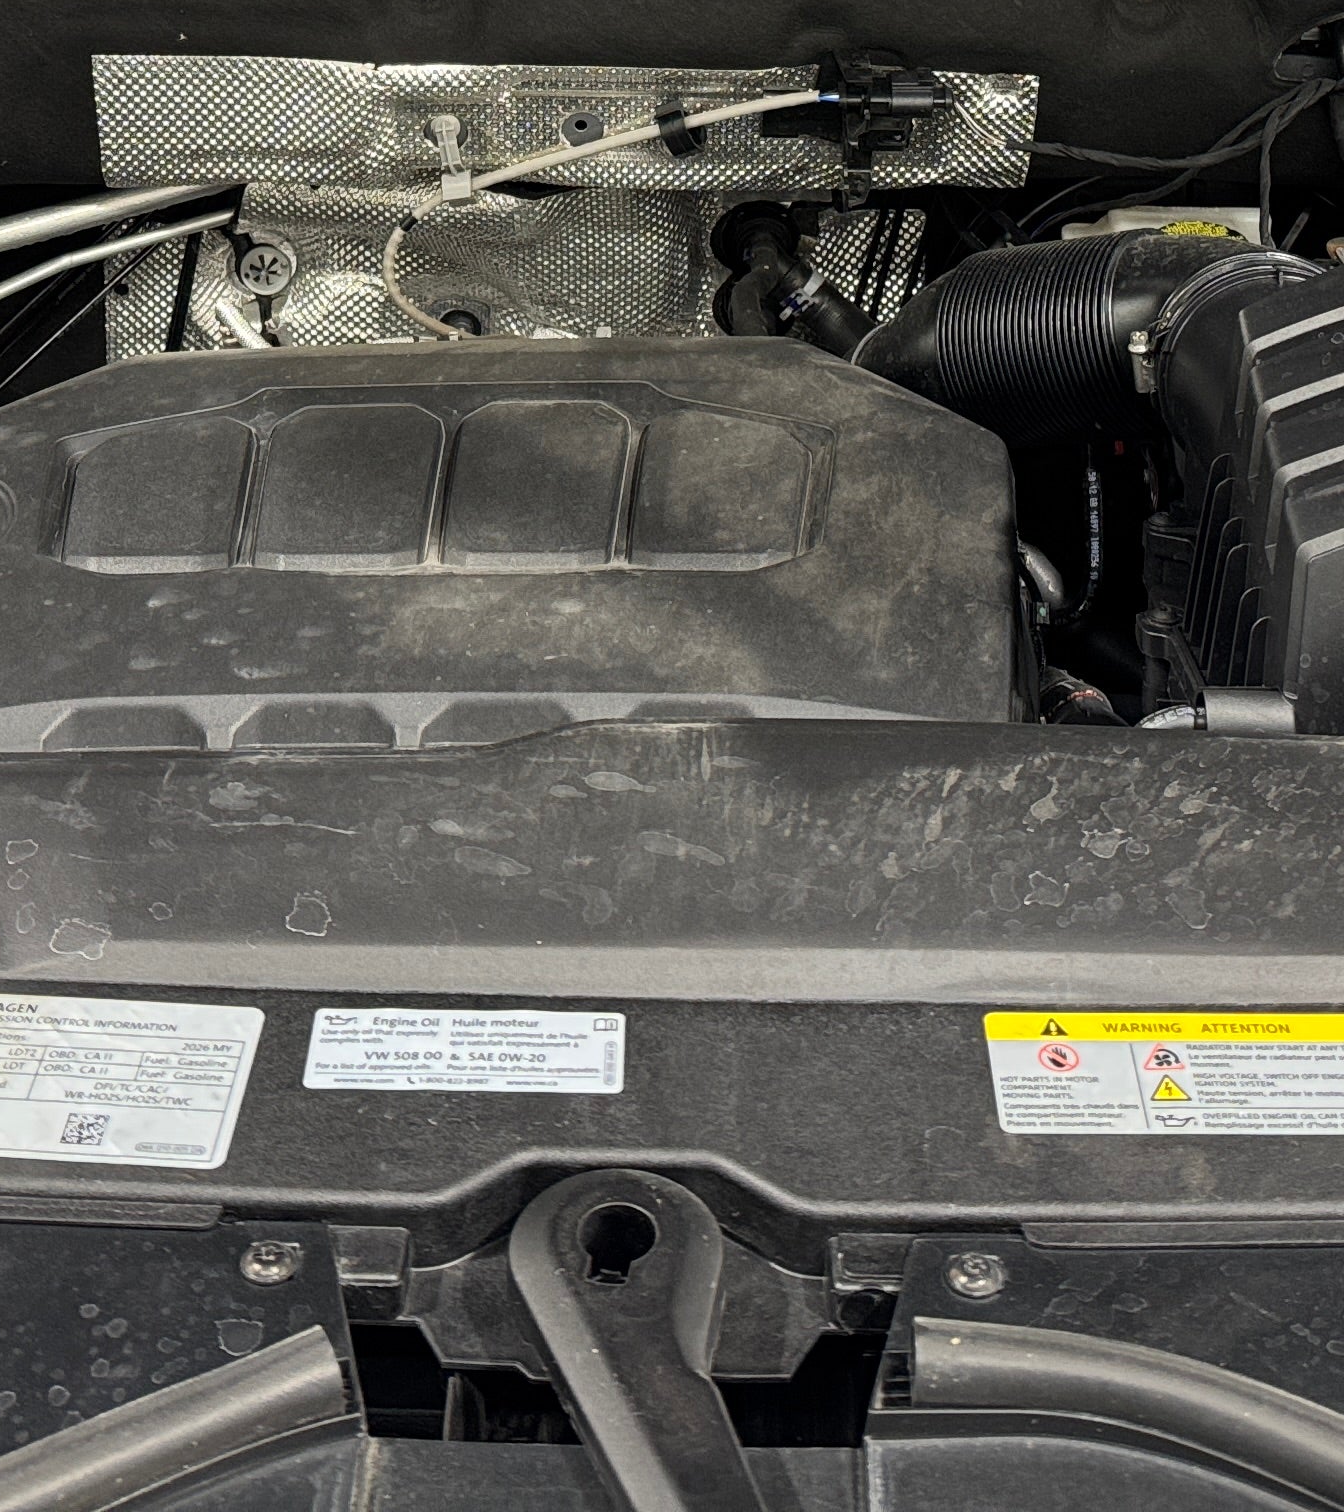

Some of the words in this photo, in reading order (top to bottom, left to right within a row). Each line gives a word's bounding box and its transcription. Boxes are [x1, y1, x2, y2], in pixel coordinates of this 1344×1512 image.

[36, 1016, 90, 1027] CONTROL
[94, 1019, 178, 1032] INFORMATION
[372, 1017, 418, 1029] Engine
[421, 1017, 440, 1028] Oil
[452, 1018, 487, 1028] Huile
[490, 1018, 540, 1029] moteur
[1102, 1022, 1182, 1034] WARNING
[1201, 1023, 1291, 1035] ATTENTION
[182, 1043, 209, 1052] 2026
[212, 1044, 232, 1053] MY
[1186, 1043, 1232, 1052] RADIATOR
[1235, 1044, 1254, 1052] FAN
[1255, 1044, 1275, 1052] MAY
[1276, 1044, 1304, 1052] START
[1306, 1044, 1318, 1052] AT
[1319, 1044, 1339, 1052] ANY
[364, 1050, 391, 1061] VW
[394, 1050, 419, 1061] 508
[423, 1051, 442, 1061] 00
[450, 1052, 460, 1061] &
[468, 1051, 494, 1062] SAE
[498, 1052, 546, 1063] 0W-20
[1188, 1052, 1198, 1060] Le
[1200, 1052, 1253, 1060] ventilateur
[1314, 1054, 1335, 1062] peut
[178, 1058, 228, 1068] Gasoline
[173, 1071, 224, 1082] Gasoline
[1193, 1072, 1216, 1080] HIGH
[1263, 1072, 1300, 1080] SWITCH
[1194, 1080, 1237, 1088] IGNITION
[1197, 1089, 1226, 1097] Haute
[1004, 1102, 1061, 1111] Composants
[1016, 1112, 1085, 1120] compartiment
[1202, 1112, 1260, 1120] OVERFILLED
[1262, 1112, 1298, 1120] ENGINE
[1300, 1112, 1316, 1120] OIL
[1318, 1112, 1338, 1120] CAN
[1204, 1121, 1264, 1130] Remplissage
[1267, 1121, 1304, 1129] excessif
